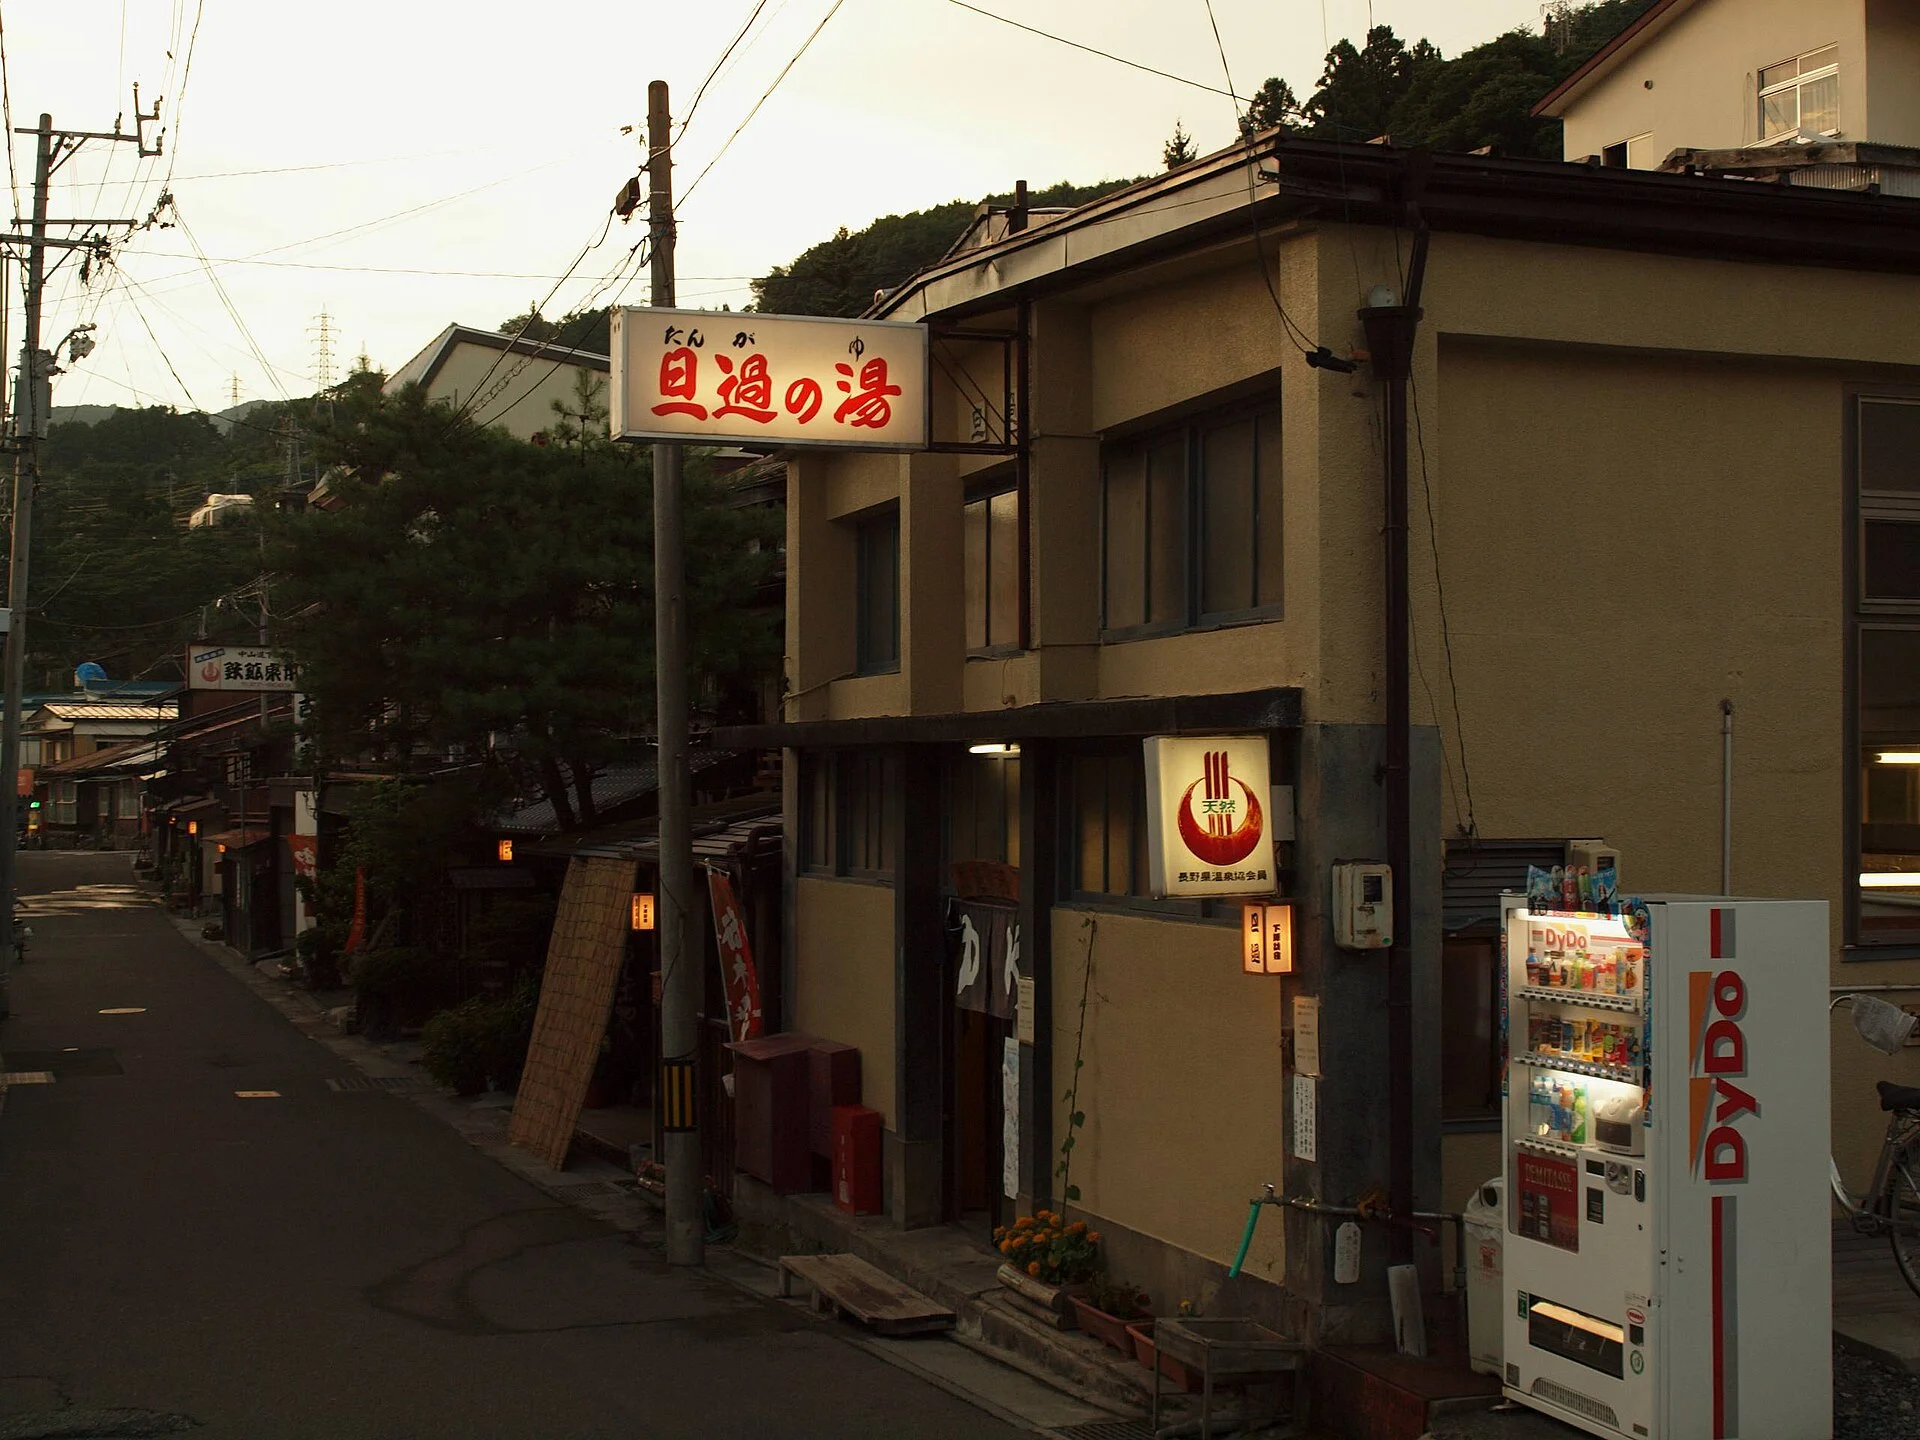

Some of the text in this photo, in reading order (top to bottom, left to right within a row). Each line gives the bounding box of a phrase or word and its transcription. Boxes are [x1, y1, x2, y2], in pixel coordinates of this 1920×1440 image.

[664, 325, 865, 361] たん が ゆ
[651, 347, 902, 429] 旦過の湯
[1201, 799, 1236, 814] 天然
[1177, 869, 1269, 883] 長野県温泉協会員
[1545, 928, 1587, 951] DyDo
[1704, 970, 1758, 1181] DyDo
